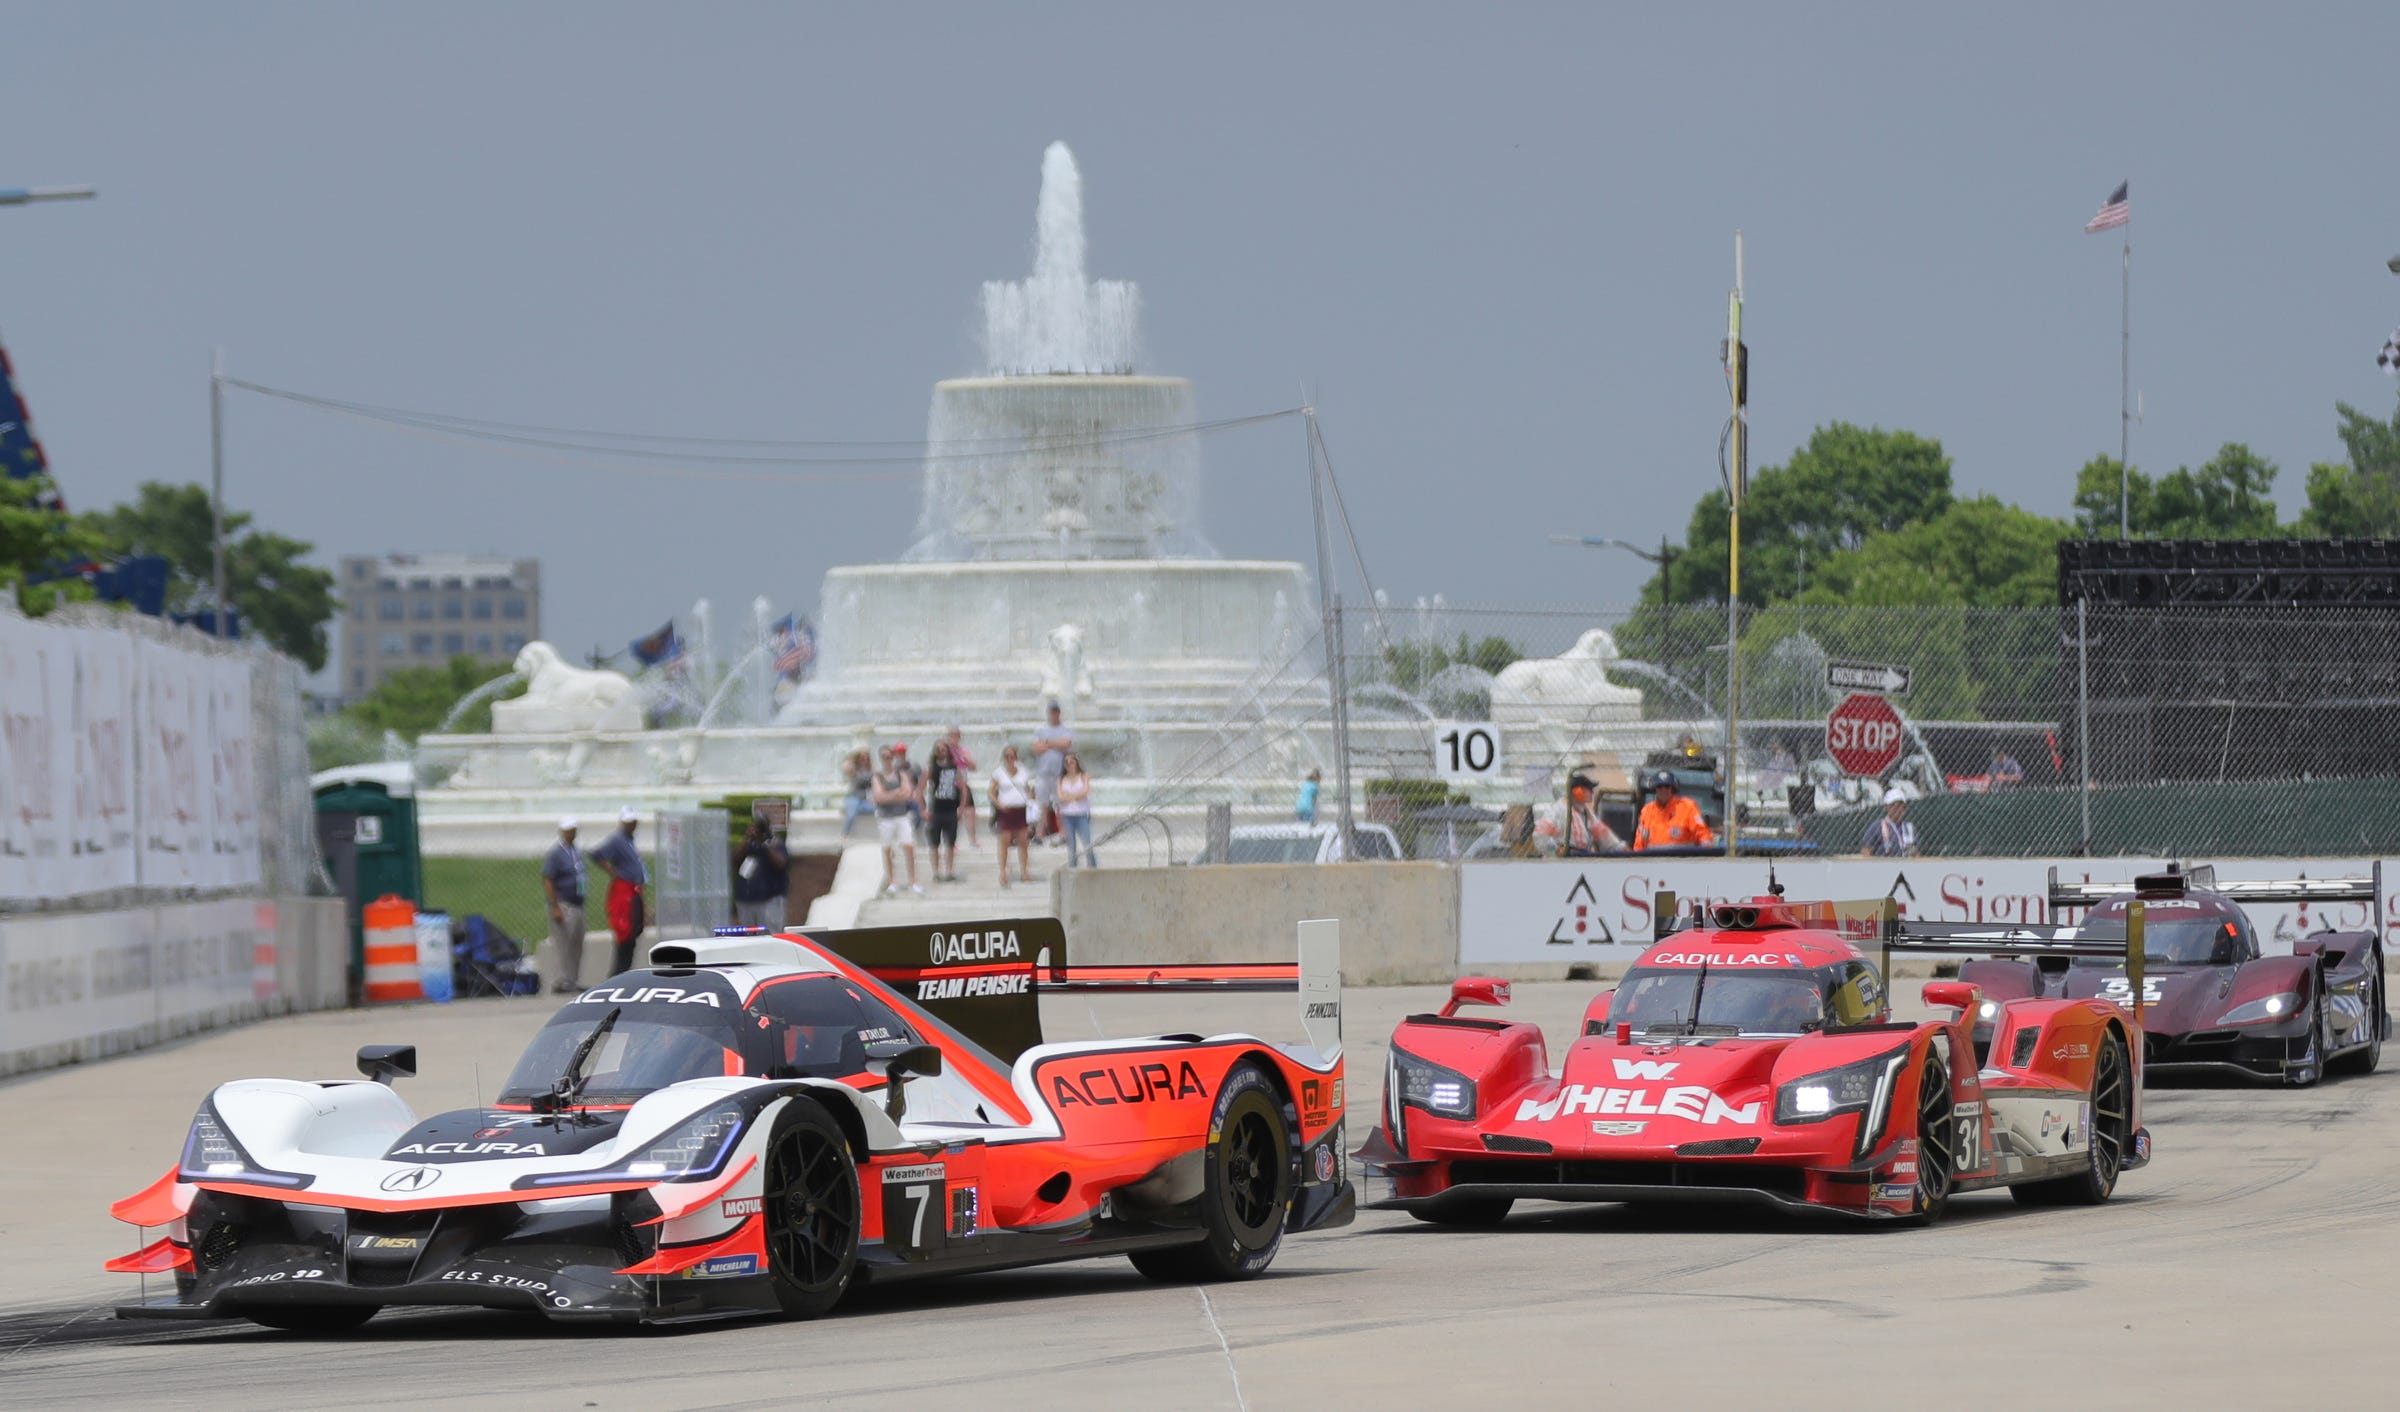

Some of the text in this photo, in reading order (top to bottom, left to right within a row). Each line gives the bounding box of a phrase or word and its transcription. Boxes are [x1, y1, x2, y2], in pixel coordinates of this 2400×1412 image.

[1831, 716, 1897, 753] STOP
[1441, 728, 1495, 773] 10
[2111, 899, 2201, 911] mzda
[1845, 910, 1878, 939] WHELEN
[945, 930, 1020, 961] ACURA
[1653, 952, 1780, 966] CADILLAC
[917, 973, 1032, 1001] TEAM PENSKE
[1304, 1002, 1338, 1019] PENNZOIL
[866, 1027, 890, 1040] TAYLOR
[1053, 1060, 1208, 1108] ACURA
[1514, 1084, 1762, 1124] WHELEN
[390, 1142, 545, 1155] ACURA
[1956, 1117, 1980, 1171] 31
[885, 1166, 945, 1180] WeatherTech
[724, 1198, 763, 1216] MOTUL
[905, 1184, 930, 1248] 7
[373, 1237, 418, 1249] IMSA
[291, 1269, 324, 1279] 3D
[708, 1260, 750, 1273] MICHELIN
[441, 1270, 573, 1308] ELS STUDIO
